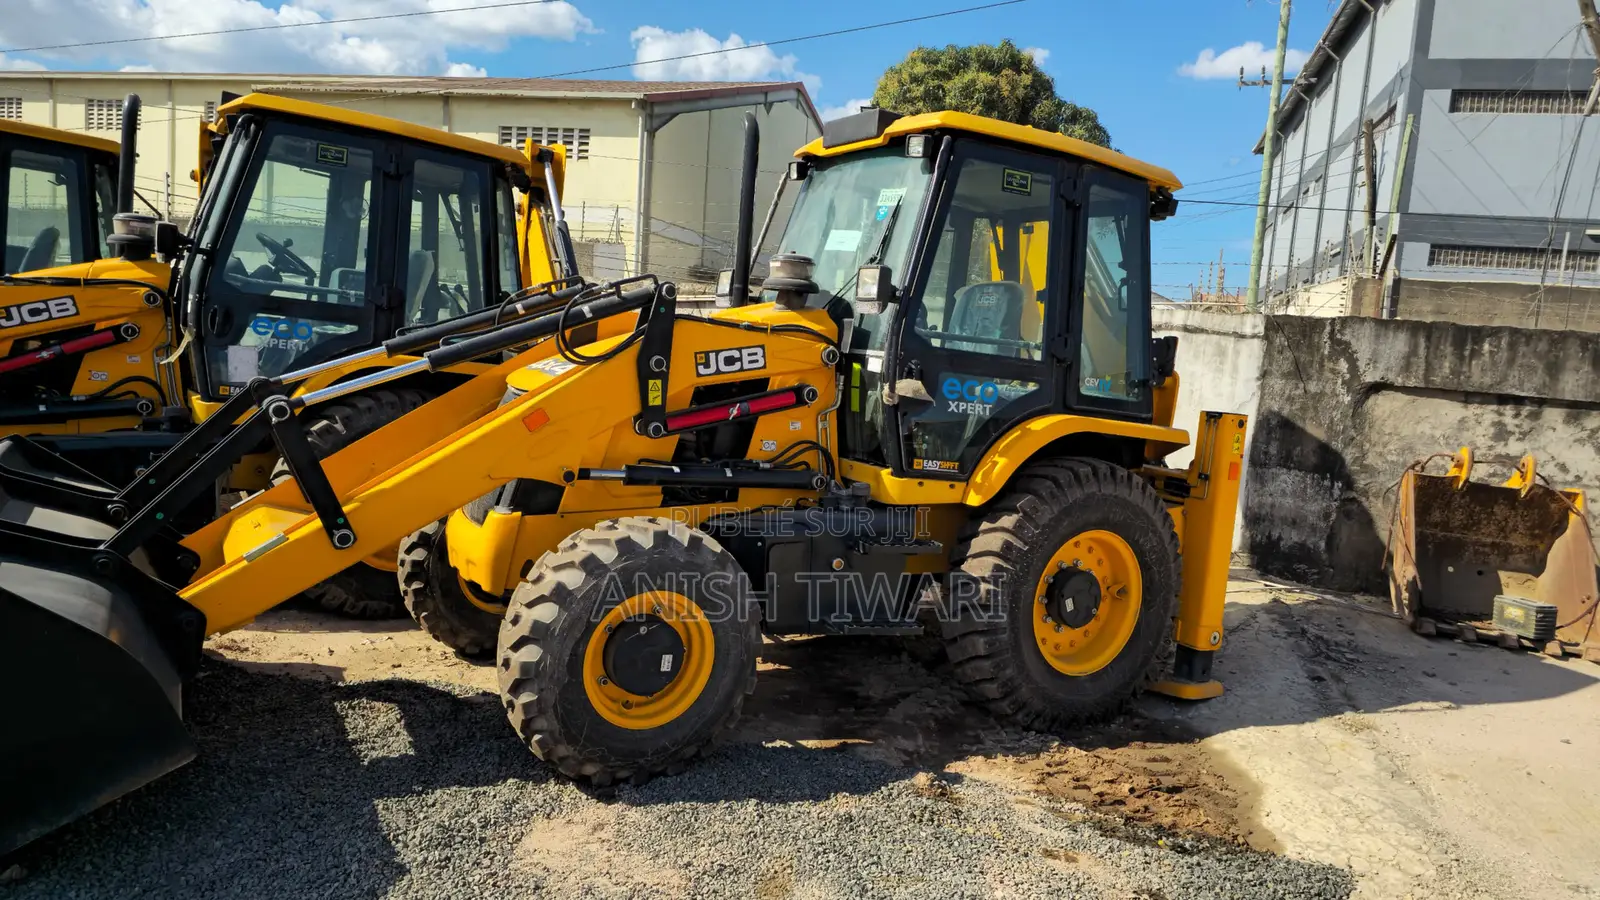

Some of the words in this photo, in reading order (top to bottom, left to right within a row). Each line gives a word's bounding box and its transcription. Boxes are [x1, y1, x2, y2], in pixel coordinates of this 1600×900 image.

[0, 298, 77, 327] JCB
[251, 317, 313, 341] eco
[698, 347, 765, 375] JCB
[942, 377, 999, 404] eco
[947, 401, 993, 416] XPERT
